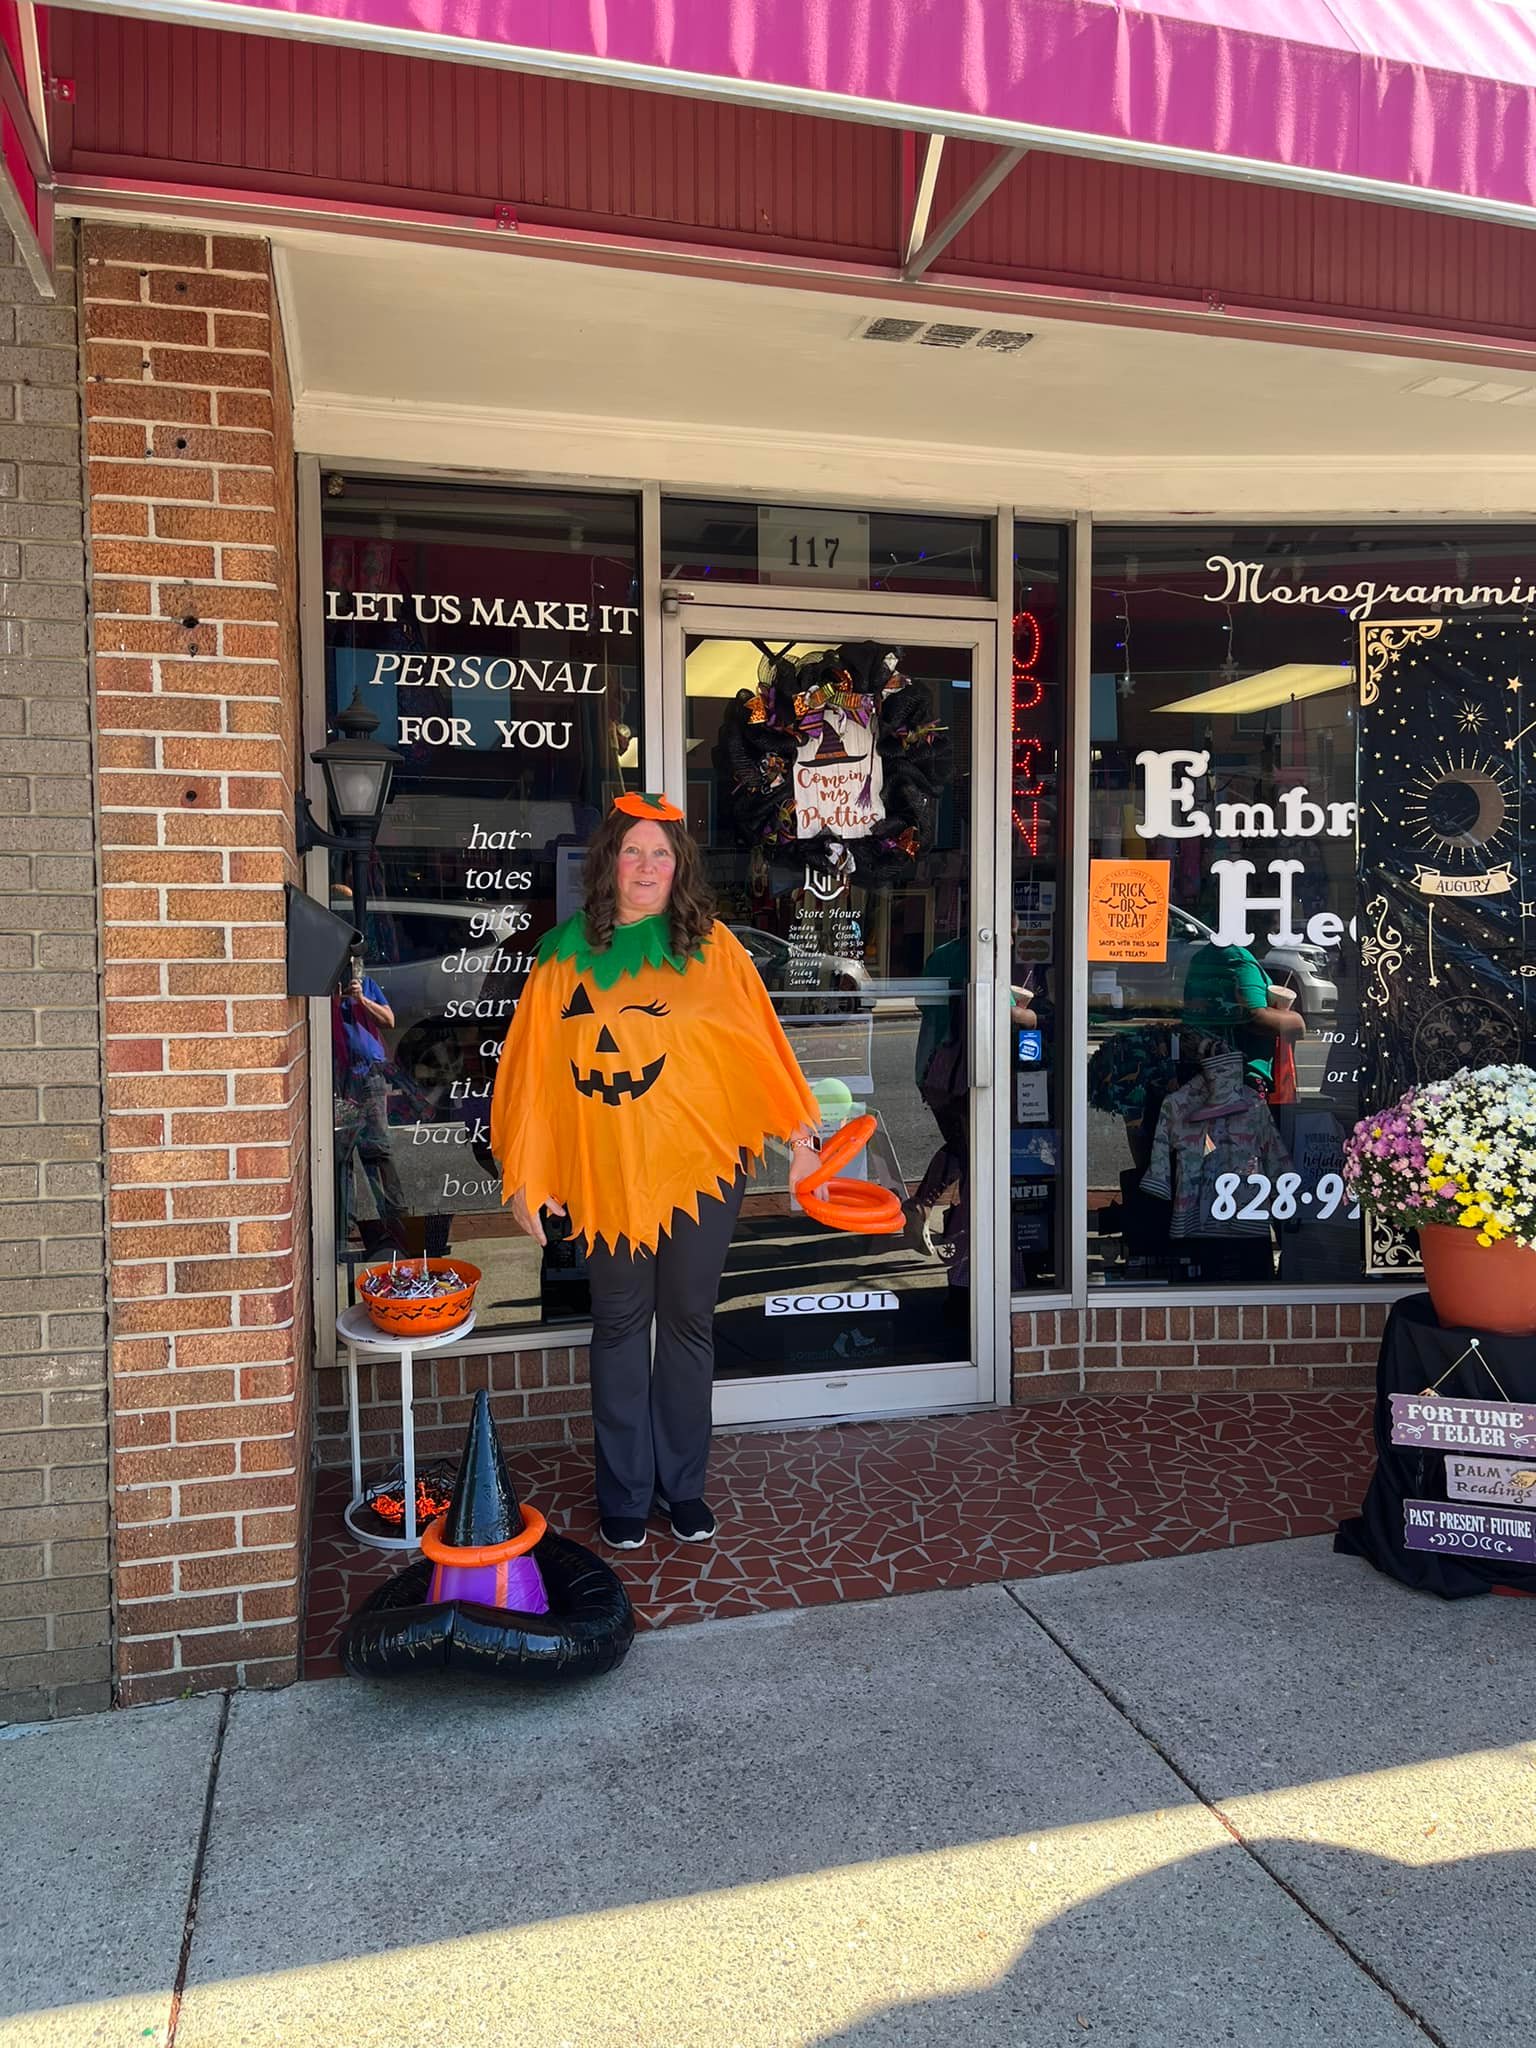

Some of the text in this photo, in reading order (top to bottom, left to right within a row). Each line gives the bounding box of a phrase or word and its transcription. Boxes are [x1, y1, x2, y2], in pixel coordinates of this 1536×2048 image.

[789, 534, 840, 569] 117
[325, 591, 639, 635] LET US MAKE IT
[368, 653, 607, 695] PERSONAL
[398, 716, 573, 750] FOR YOU
[797, 768, 865, 789] Come in
[819, 788, 851, 804] my
[798, 806, 879, 830] Pretties
[465, 868, 532, 890] totes
[1436, 879, 1491, 893] AUGURY
[1110, 882, 1146, 898] TRICK
[796, 907, 861, 919] Store Hours
[1120, 898, 1138, 915] OR
[1210, 859, 1357, 948] He
[469, 904, 532, 938] gifts
[788, 924, 815, 932] Sunday
[1108, 914, 1147, 930] TREAT
[788, 933, 818, 941] Monday
[789, 942, 818, 951] Tuesday
[789, 960, 823, 969] Thursday
[789, 969, 813, 978] Friday
[789, 978, 821, 987] Saturday
[1327, 1069, 1359, 1082] or t
[412, 1118, 492, 1150] back
[1303, 1152, 1346, 1170] holida
[442, 1173, 504, 1197] bow
[1011, 1185, 1048, 1198] NFIB
[770, 1292, 892, 1313] SCOUT
[1407, 1404, 1524, 1428] FORTUNE
[1427, 1422, 1506, 1447] TELLER
[1454, 1463, 1500, 1478] PALM
[1454, 1480, 1533, 1504] Readings
[1409, 1508, 1532, 1539] PAST PRESENT FUTURE
